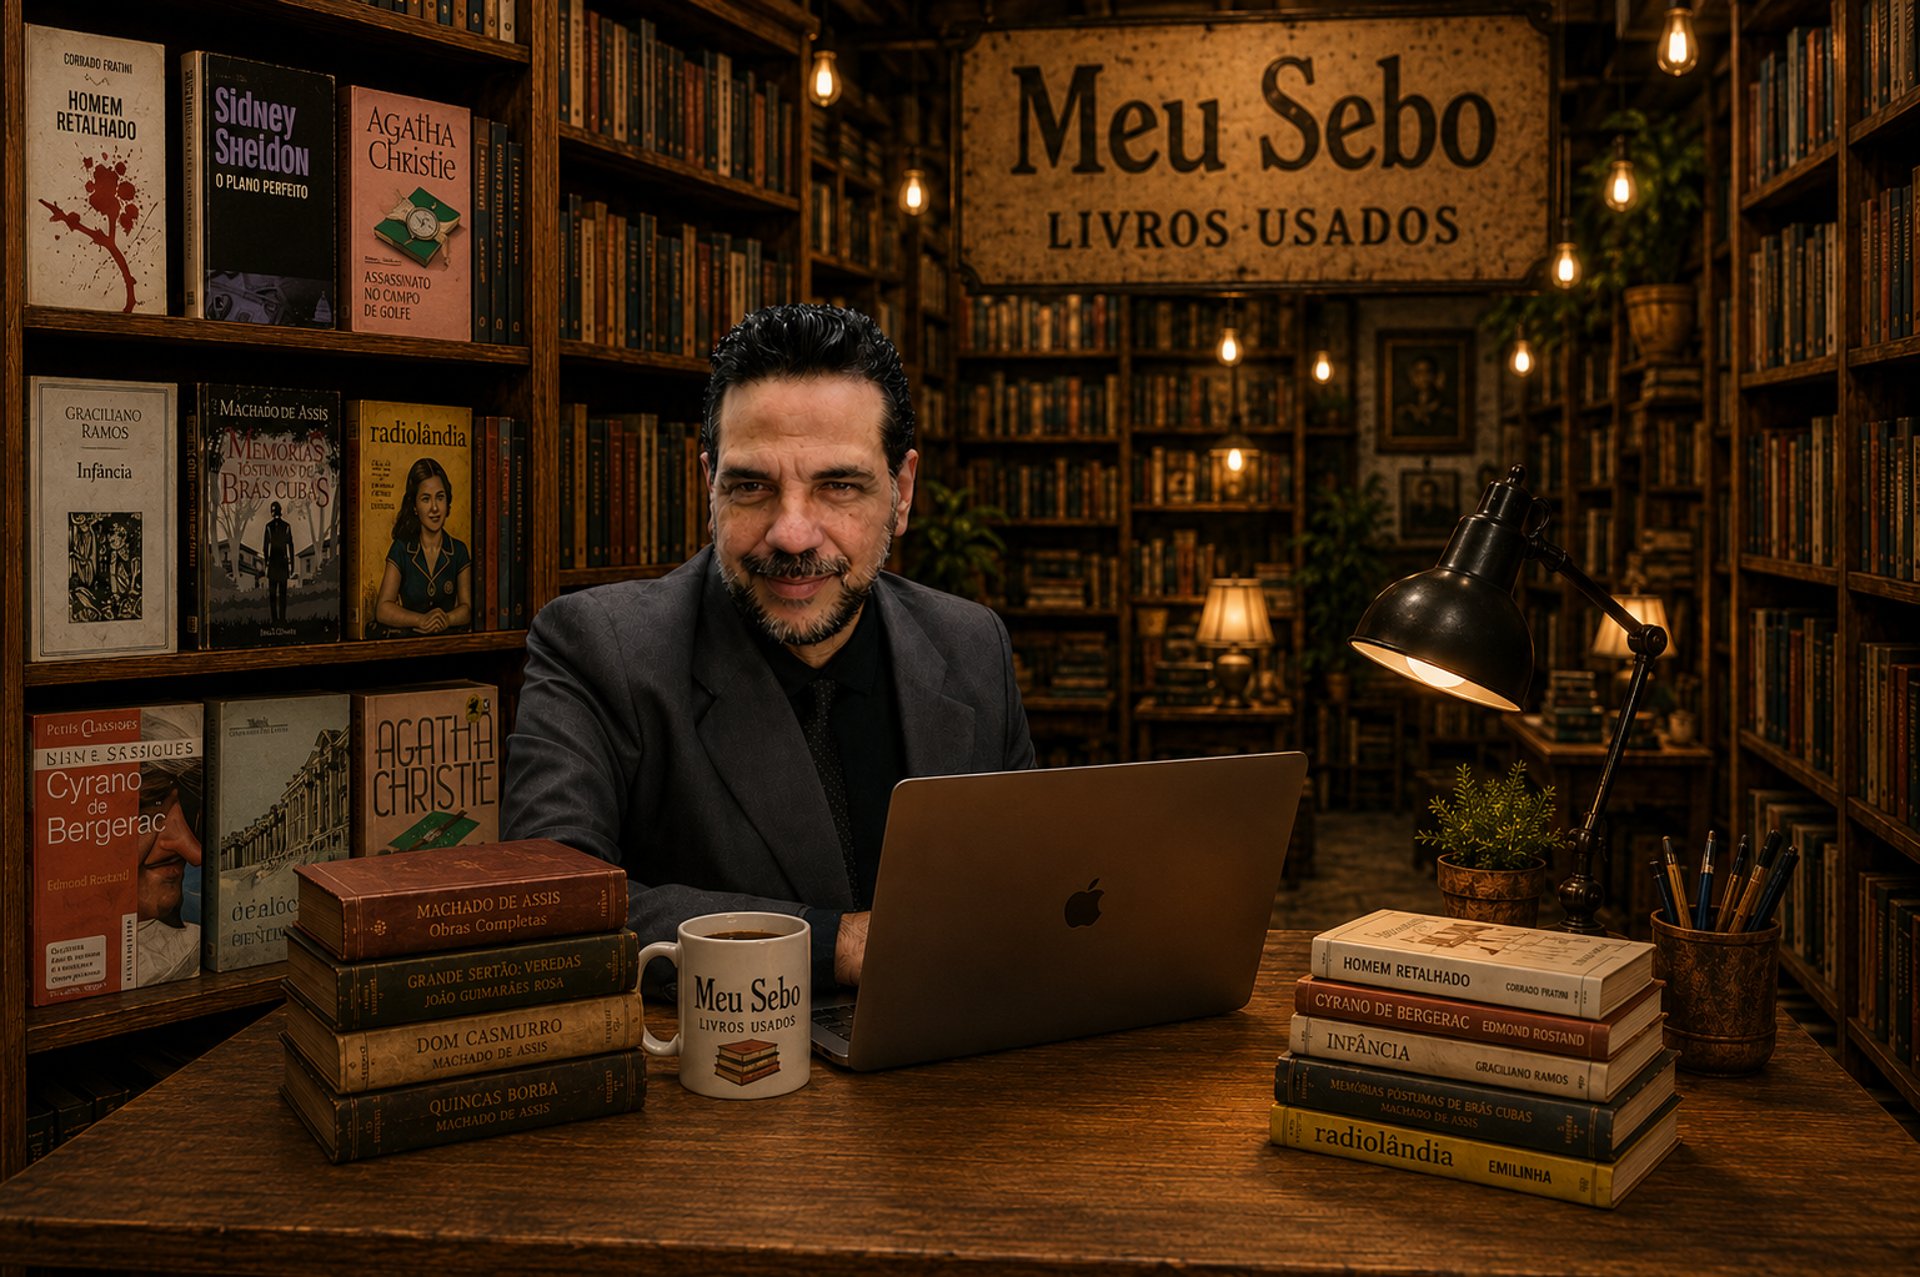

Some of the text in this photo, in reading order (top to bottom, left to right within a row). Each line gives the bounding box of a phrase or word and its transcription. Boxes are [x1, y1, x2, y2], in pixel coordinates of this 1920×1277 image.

[63, 52, 133, 74] CORRADO FRATINI
[68, 89, 122, 117] HOMEM
[215, 86, 296, 141] Sidney
[1010, 54, 1496, 174] Meu Sebo
[56, 111, 137, 140] RETALHADO
[215, 128, 309, 176] Sheldon
[215, 173, 308, 199] O PLANO PERFEITO
[1048, 205, 1460, 250] LIVROS USADOS
[364, 271, 431, 290] ASSASSINATO
[364, 287, 420, 305] NO CAMPO
[364, 303, 411, 320] DE GOLFE
[65, 406, 142, 422] GRACILIANO
[220, 399, 328, 421] MACHADO DE ASSIS
[81, 423, 129, 439] RAMOS
[370, 420, 467, 447] radiolândia
[275, 477, 329, 507] CUBAS
[375, 712, 493, 769] AGATHA
[47, 771, 142, 804] Cyrano
[374, 760, 495, 817] CHRISTIE
[87, 799, 108, 815] de
[48, 812, 166, 846] Bergerac
[417, 891, 560, 919] MACHADO DE ASSIS
[429, 914, 548, 937] Obras Completas
[407, 954, 581, 989] GRANDE SERTÃO: VEREDAS
[1343, 956, 1391, 976] HOMEM
[1396, 964, 1470, 987] RETALHADO
[1505, 982, 1539, 996] CORRADO
[460, 981, 529, 1001] GUIMARÃES
[694, 975, 800, 1013] Meu Sebo
[699, 1015, 796, 1033] LIVROS USADOS
[1315, 993, 1585, 1047] CYRANO DE BERGERAC EDMOND ROSTAND
[416, 1018, 562, 1054] DOM CASMURRO
[432, 1041, 548, 1069] MACHADO DE ASSIS
[1327, 1032, 1568, 1085] INFÂNCIA GRACILIANO RAMOS
[429, 1081, 558, 1116] QUINCAS BORBA
[1387, 1086, 1444, 1108] PÓSTUMAS
[1448, 1098, 1461, 1111] DE
[1495, 1106, 1533, 1123] CUBAS
[436, 1103, 551, 1132] MACHADO DE ASSIS
[1434, 1111, 1448, 1124] DE
[1451, 1114, 1479, 1129] ASSIS
[1314, 1125, 1454, 1167] radiolândia
[1488, 1159, 1552, 1184] EMILINHA
